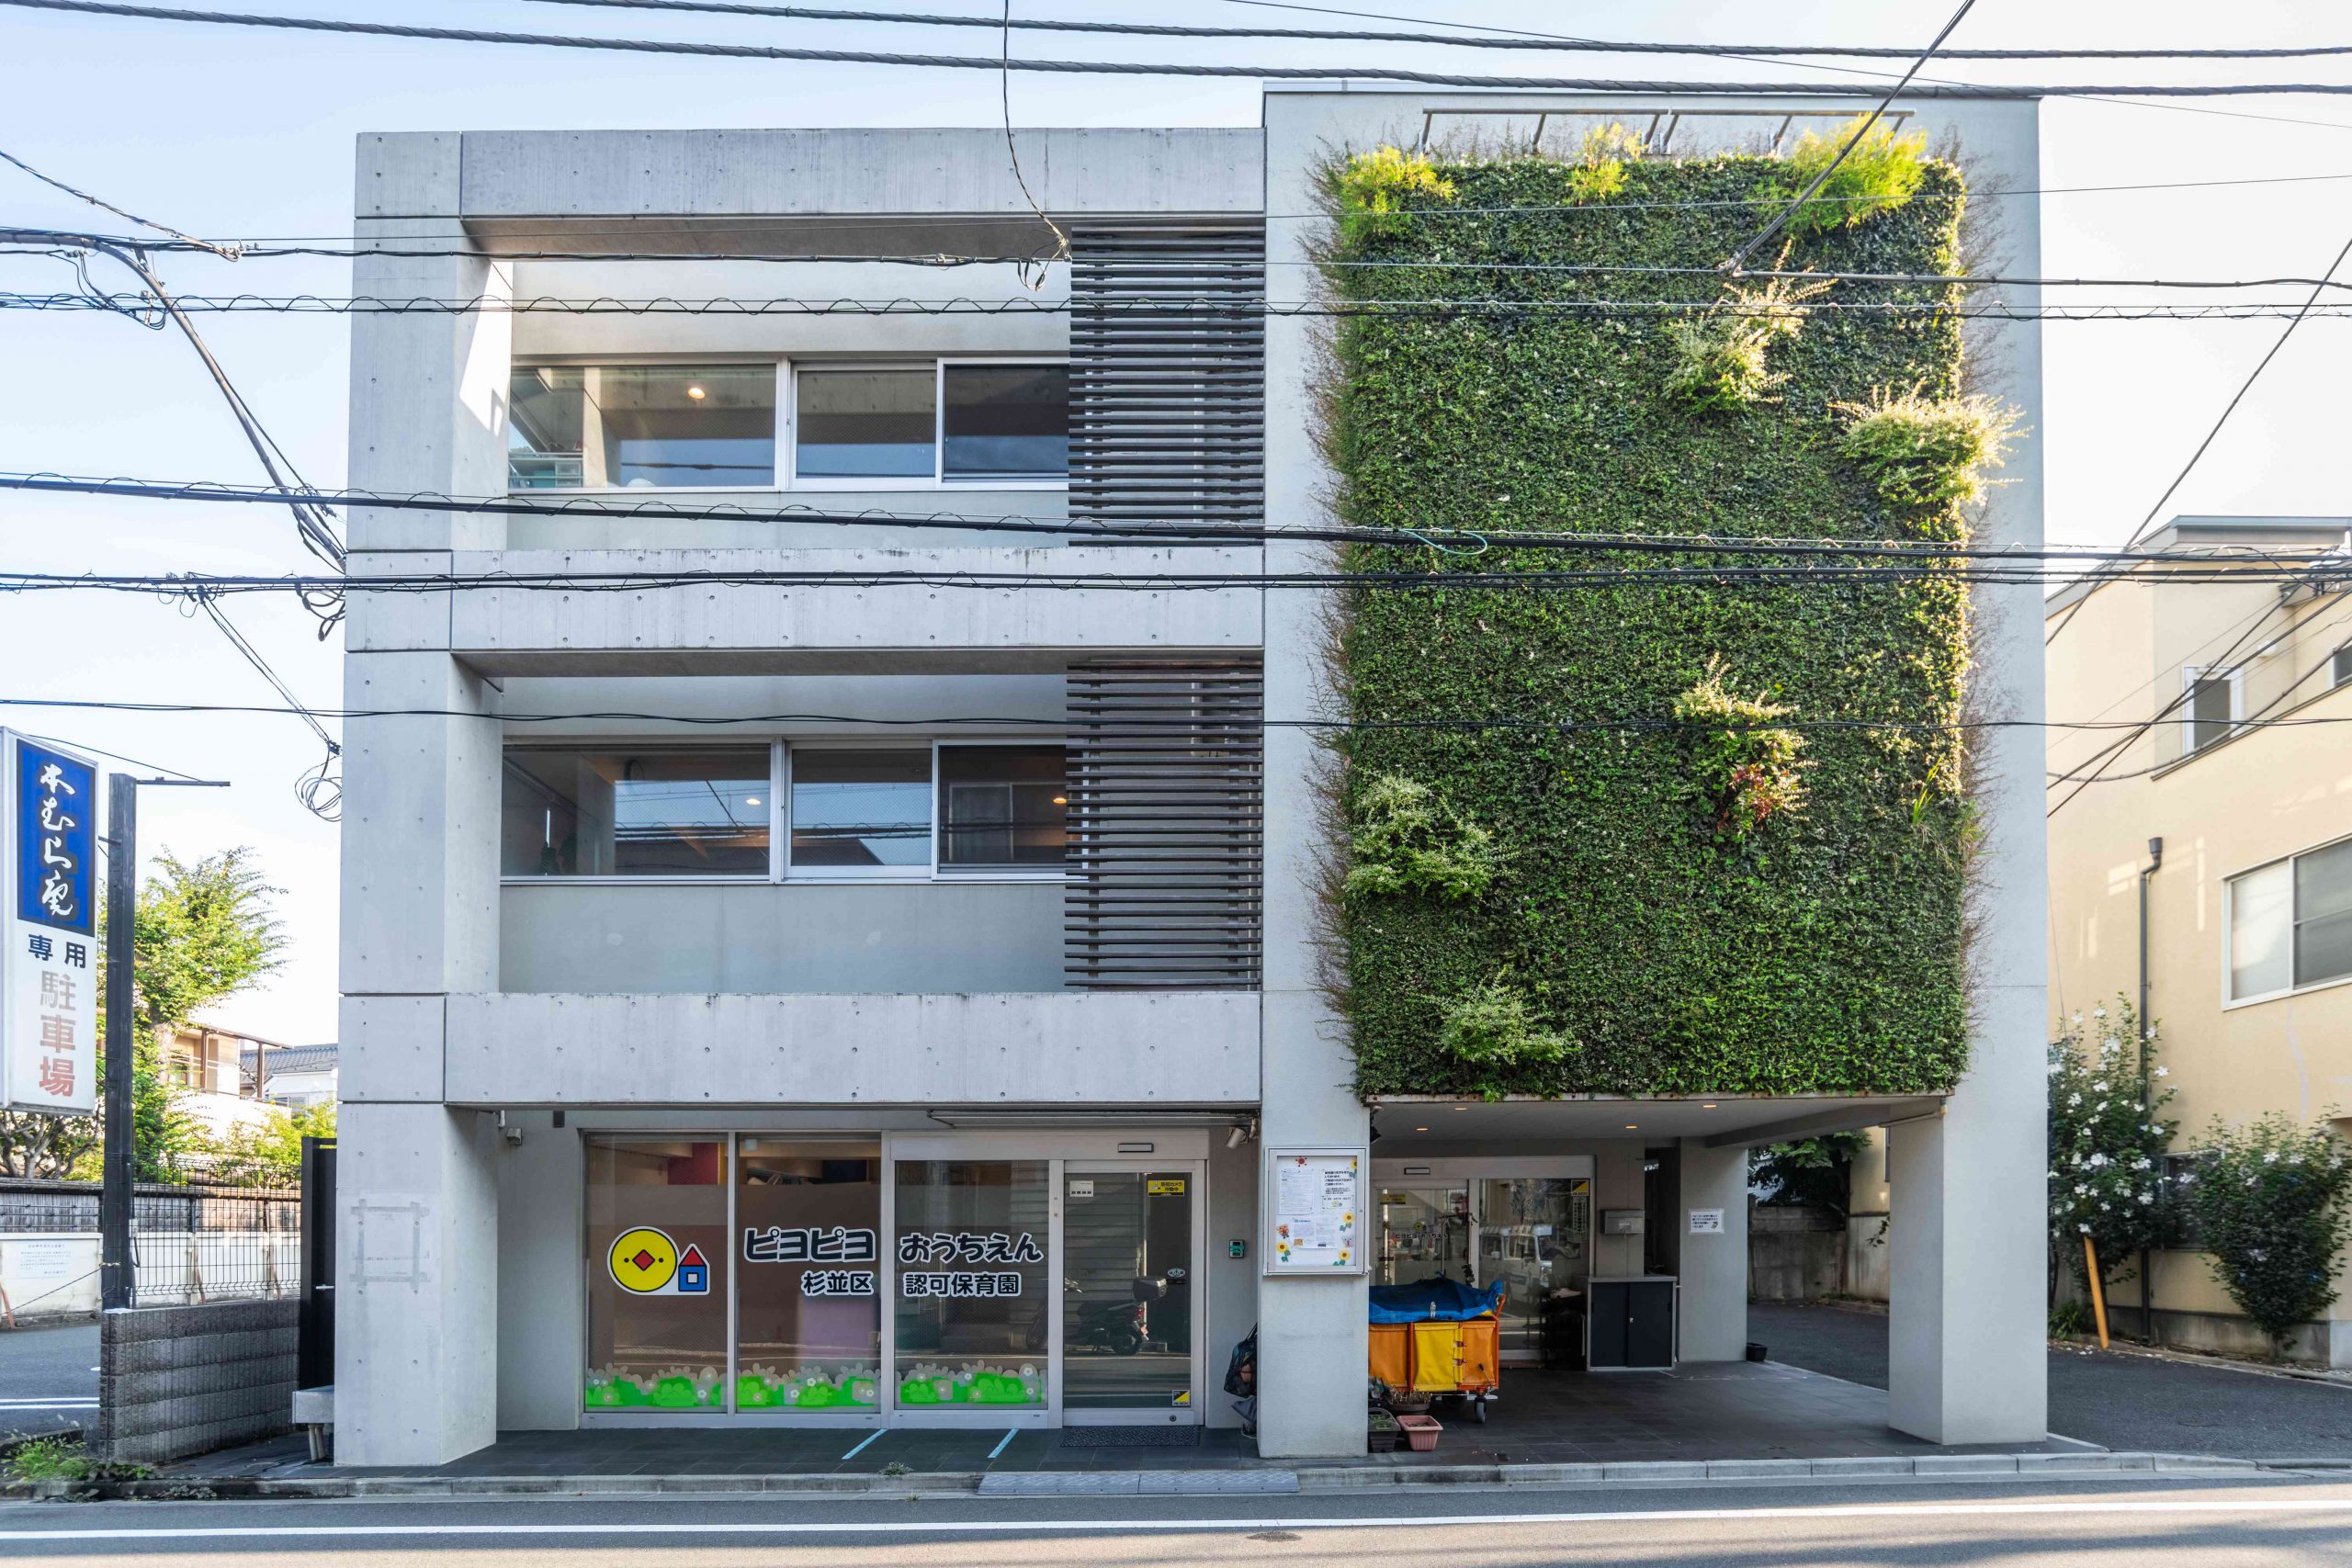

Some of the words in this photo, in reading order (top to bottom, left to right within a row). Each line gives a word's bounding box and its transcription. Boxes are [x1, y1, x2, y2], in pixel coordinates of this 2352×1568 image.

[28, 933, 86, 969] 専用
[39, 970, 76, 1098] 駐車場
[745, 1226, 876, 1263] ピヨピヨ
[899, 1232, 1044, 1264] おうちえん
[801, 1270, 874, 1296] 杉並区
[903, 1271, 1022, 1297] 認可保育園
